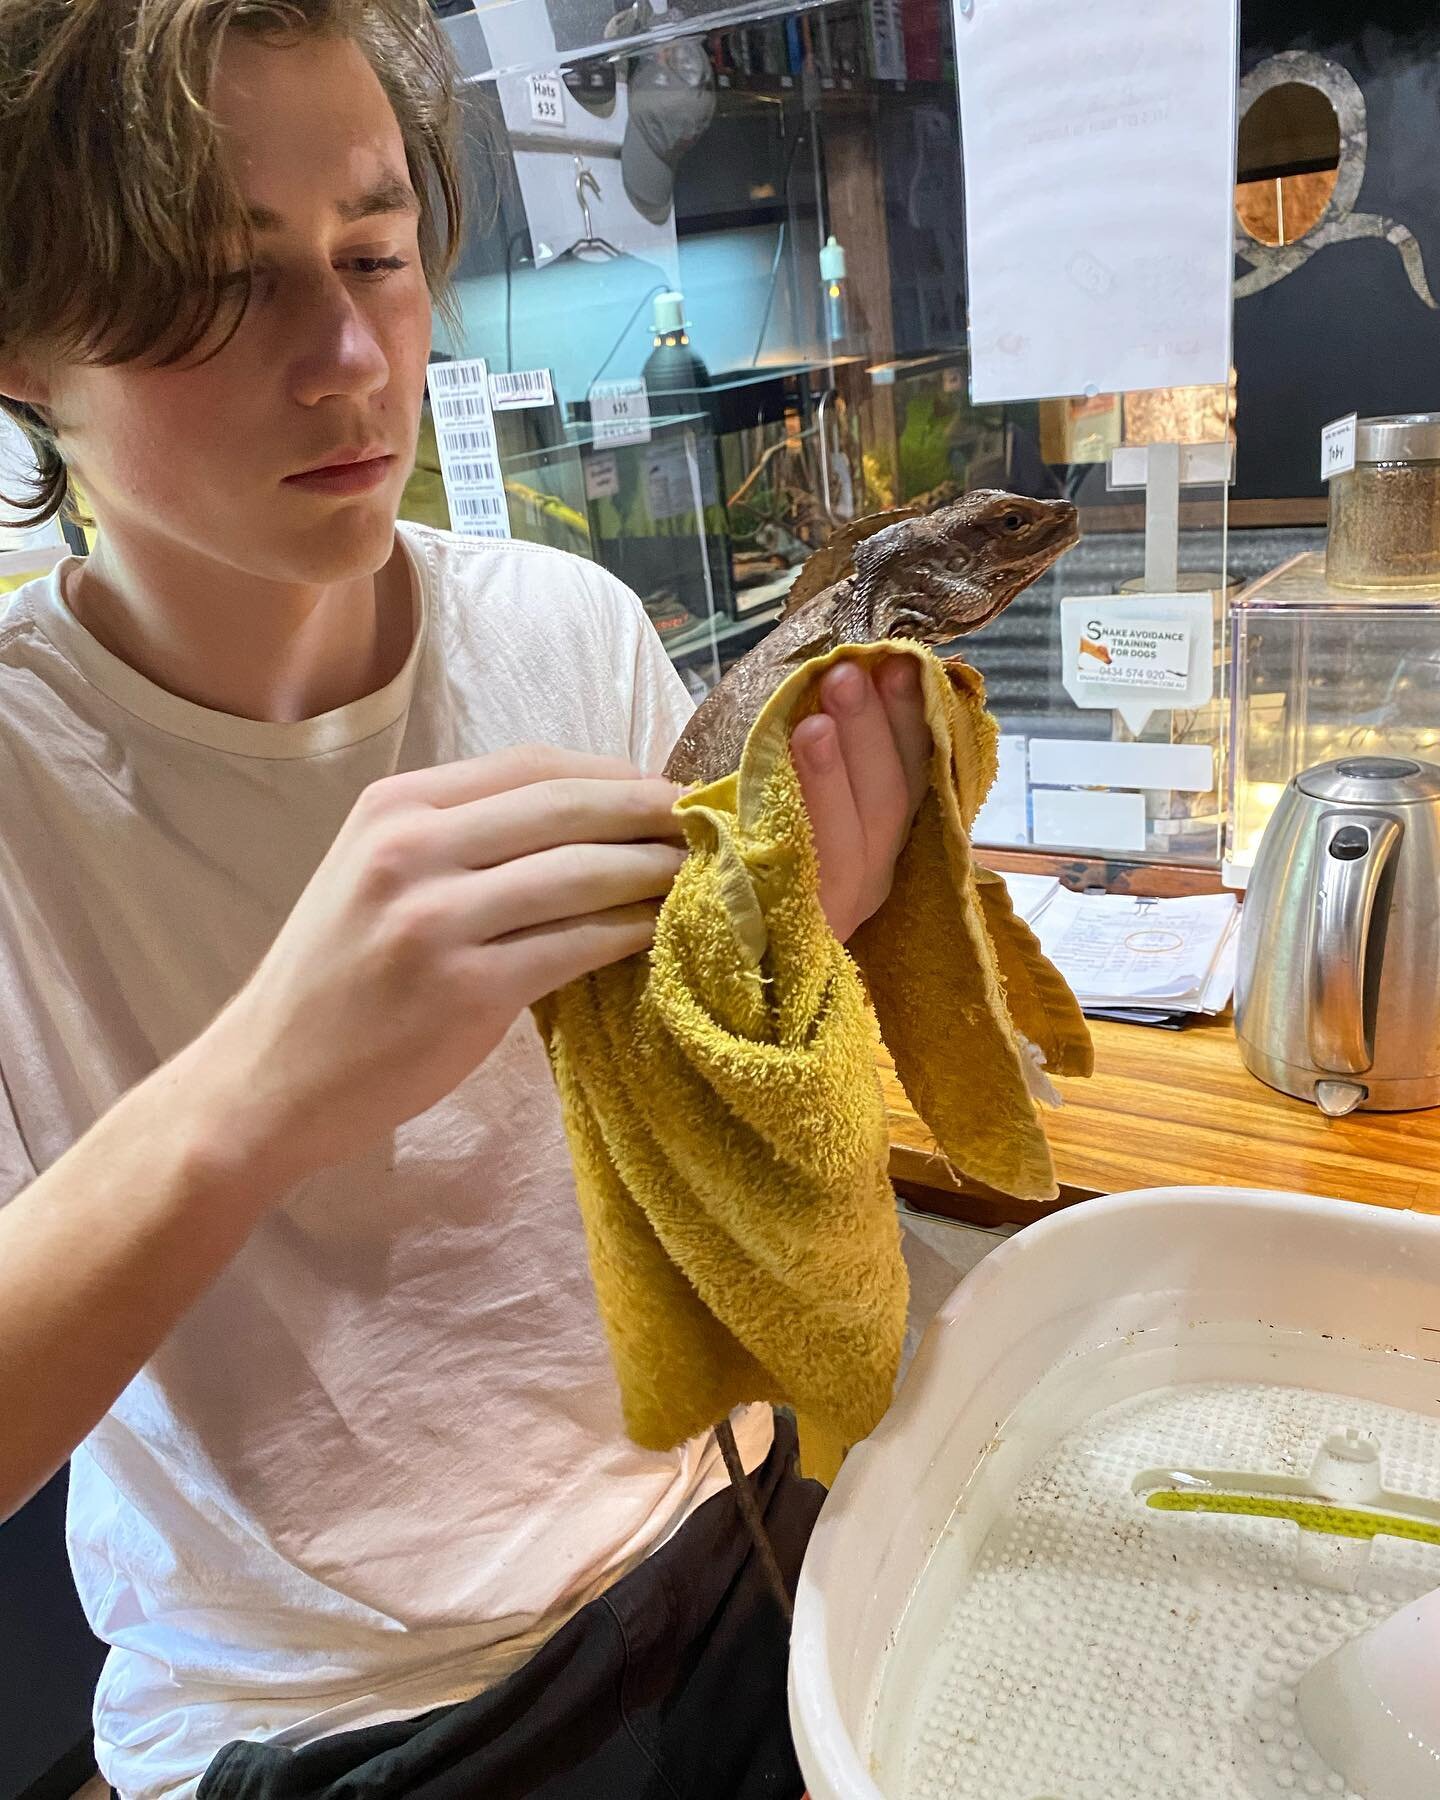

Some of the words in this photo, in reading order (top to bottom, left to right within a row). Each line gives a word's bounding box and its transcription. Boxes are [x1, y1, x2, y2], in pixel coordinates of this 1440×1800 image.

[533, 82, 556, 97] Hats
[538, 101, 556, 116] $35
[1087, 621, 1128, 640] SNAKE
[1129, 630, 1184, 641] AVOIDANCE
[1112, 639, 1157, 649] TRAINING
[1110, 648, 1129, 657] FOR
[1130, 649, 1157, 659] DOGS
[1099, 666, 1122, 676] 0434
[1126, 668, 1144, 678] 574
